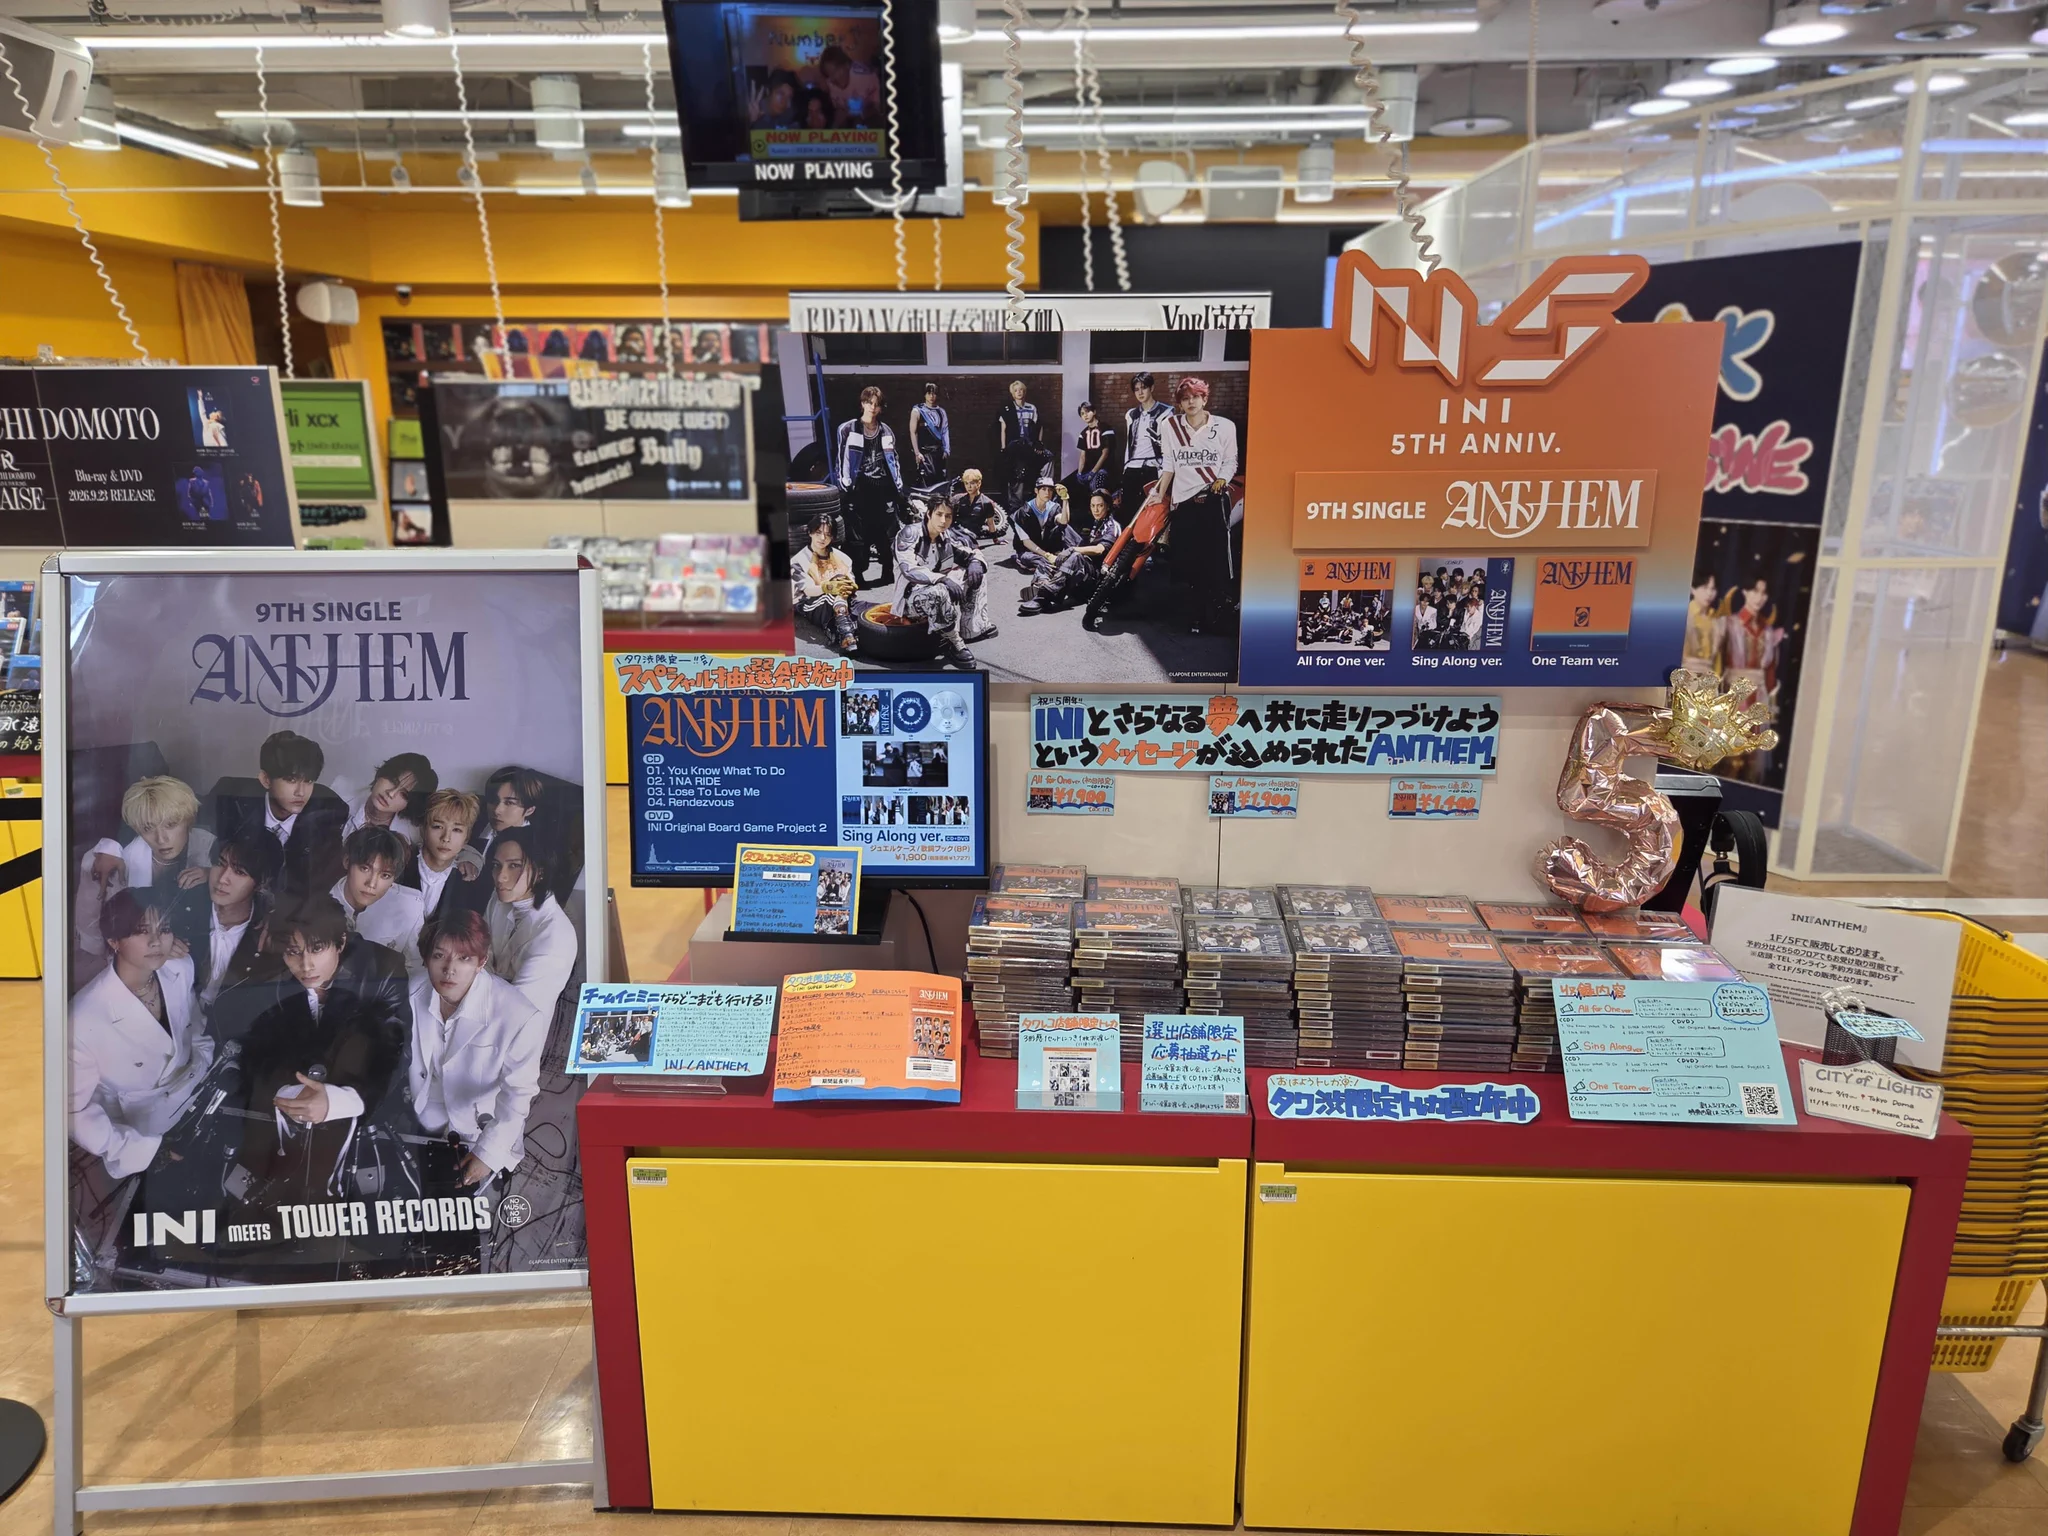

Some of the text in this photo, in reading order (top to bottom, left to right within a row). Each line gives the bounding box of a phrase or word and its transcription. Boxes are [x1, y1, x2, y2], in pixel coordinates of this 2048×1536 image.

[765, 132, 879, 143] NOW PLAYING
[755, 162, 873, 180] NOW PLAYING
[1438, 398, 1511, 424] INI
[37, 407, 160, 440] DOMOTO
[306, 412, 340, 428] xcx
[1085, 428, 1101, 449] 10
[1208, 423, 1220, 440] 5
[1391, 432, 1562, 455] 5TH ANNIV.
[640, 437, 702, 471] Bully
[75, 469, 143, 484] Blu-ray & DVD
[68, 489, 156, 501] 2026.9.23 RELEASE
[1306, 479, 1644, 539] 9TH SINGLE ANTHEM
[1325, 561, 1392, 583] ANTHEM
[1540, 561, 1633, 590] ANTHEM
[255, 601, 402, 622] 9TH SINGLE
[1485, 588, 1507, 647] ANTHEM
[1296, 656, 1386, 666] All for One ver.
[1411, 655, 1503, 668] Sing Along ver.
[1531, 656, 1619, 666] One Team ver.
[190, 631, 470, 718] ANTHEM
[619, 657, 854, 693] スペシャル抽選会実施中
[0, 716, 40, 733] 永遠
[641, 697, 828, 757] ANTHEM
[646, 755, 661, 763] CD
[646, 766, 785, 776] 01. You Know What To Do
[647, 777, 721, 786] 02. 1NA RIDE
[1031, 775, 1042, 785] All
[1214, 778, 1256, 789] Sing Along
[1398, 780, 1415, 791] One
[647, 788, 760, 797] 03. Lose To Love Me
[647, 798, 735, 807] 04. Rendezvous
[648, 812, 671, 820] DVD
[648, 823, 828, 834] INI Original Board Game Project 2
[842, 830, 873, 844] Sing
[876, 830, 917, 844] Along
[920, 832, 944, 842] ver.
[1769, 933, 1885, 961] 1F/5Fで販売しております。
[1746, 940, 1904, 975] 予約分はどちらのフロアでもお受け取り可能です。
[1768, 962, 1873, 987] 全て1F/5Fでの販売となります。
[1578, 1004, 1620, 1013] All One
[1145, 1021, 1238, 1041] 選出店舗限定
[1151, 1042, 1238, 1062] 応募抽選カード
[1584, 1041, 1633, 1052] Sing Along
[1589, 1081, 1609, 1091] One
[1612, 1082, 1637, 1091] Team
[1815, 1068, 1854, 1084] CITY
[1856, 1076, 1873, 1087] of
[1270, 1085, 1536, 1121] タワ渋限定トレカ配布中
[1868, 1095, 1915, 1109] Tokyo Dome
[133, 1196, 492, 1247] INI MEETS TOWER RECORDS
